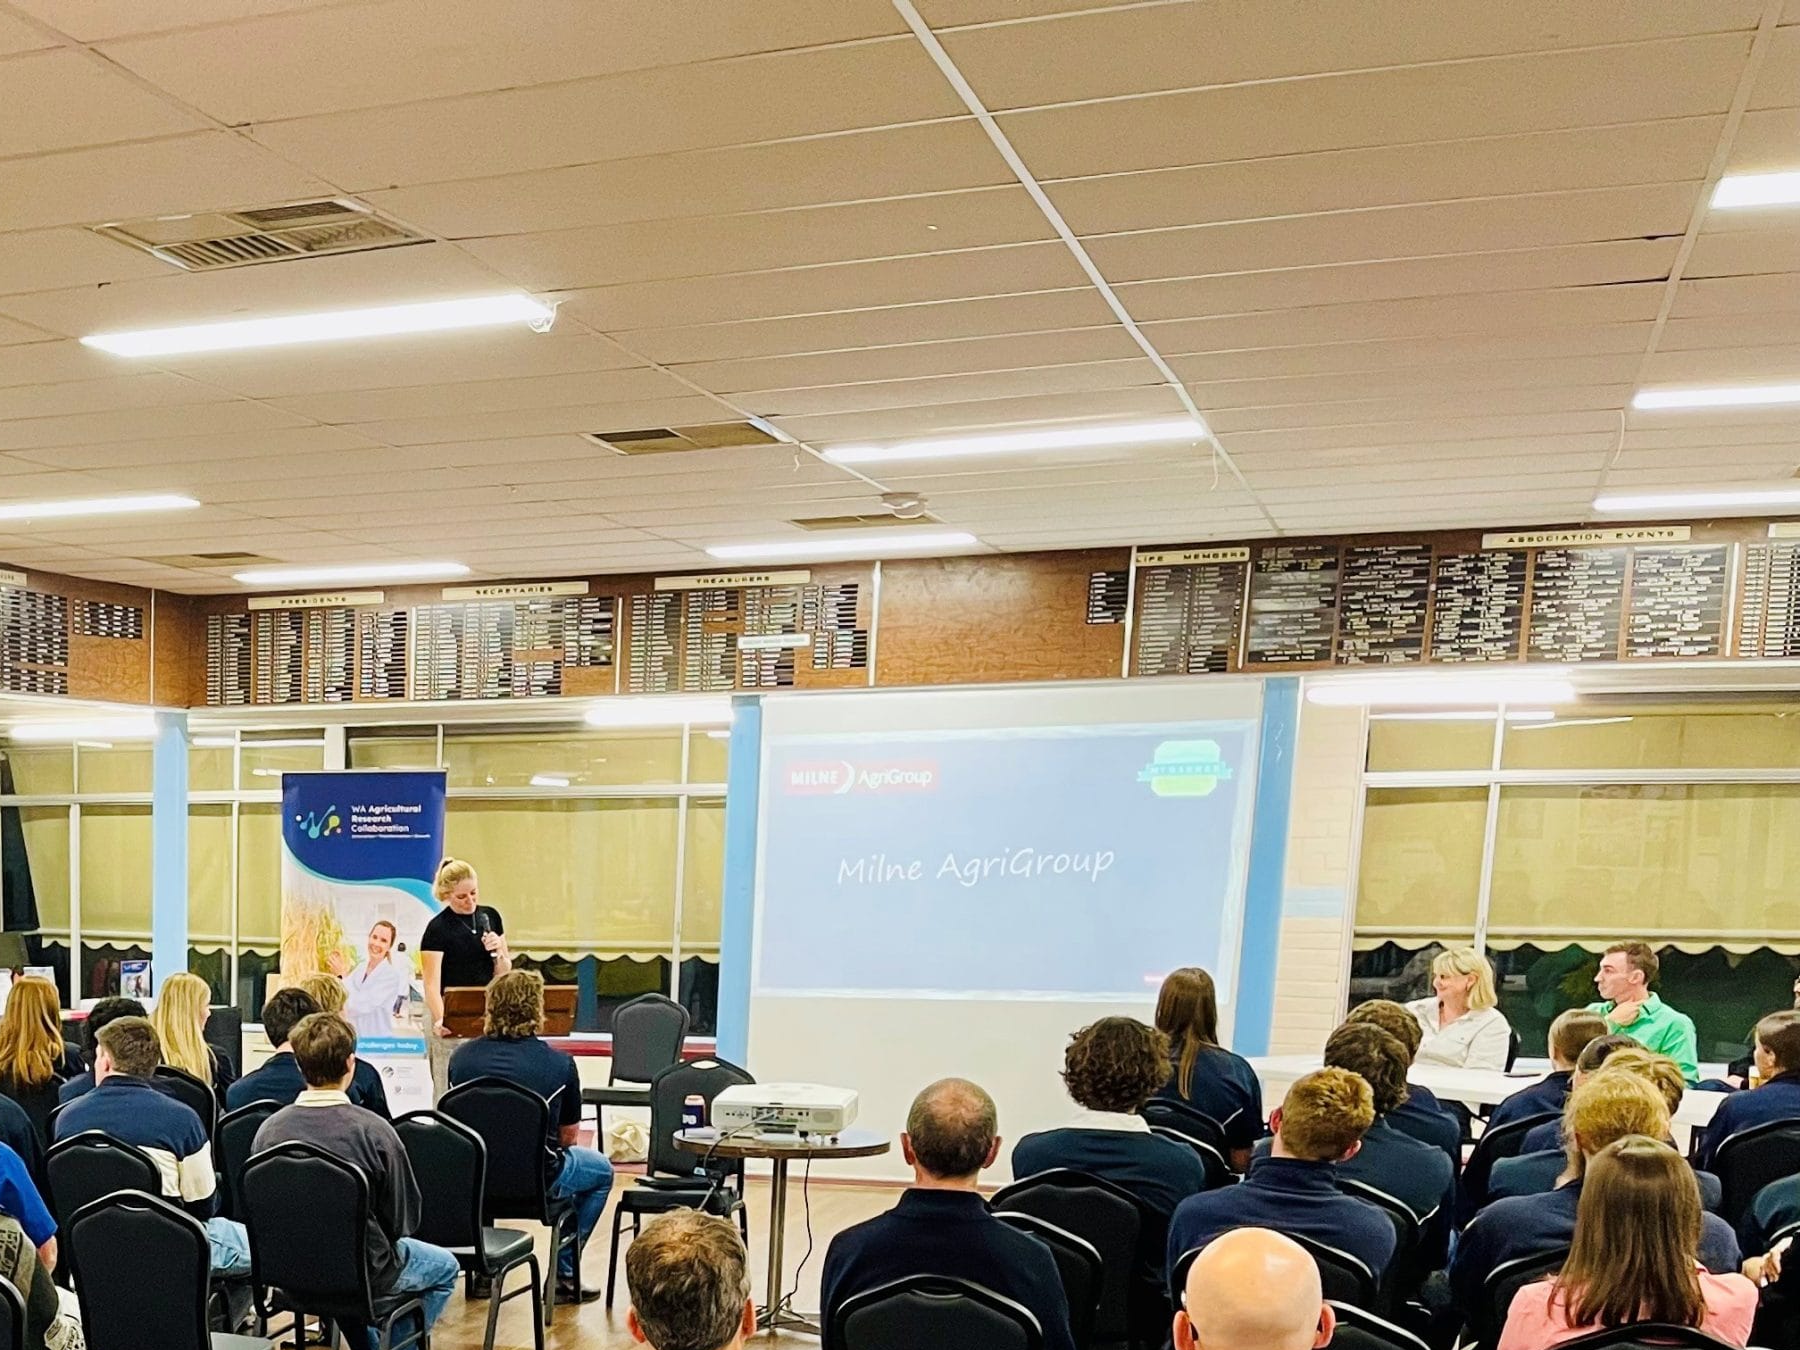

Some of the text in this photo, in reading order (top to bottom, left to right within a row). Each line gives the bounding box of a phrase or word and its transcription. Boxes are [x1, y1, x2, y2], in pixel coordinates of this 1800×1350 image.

[1506, 530, 1675, 543] ASSOCIATION EVENTS
[1183, 551, 1246, 560] MEMBERS
[696, 576, 771, 584] TREASURERS
[475, 586, 553, 595] SECRETARIES
[791, 768, 933, 789] MILNE AgriGroup
[351, 804, 422, 815] WA Agricultural
[351, 814, 392, 823] Research
[350, 824, 410, 833] Collaboration
[837, 847, 1115, 887] Milne AgriGroup
